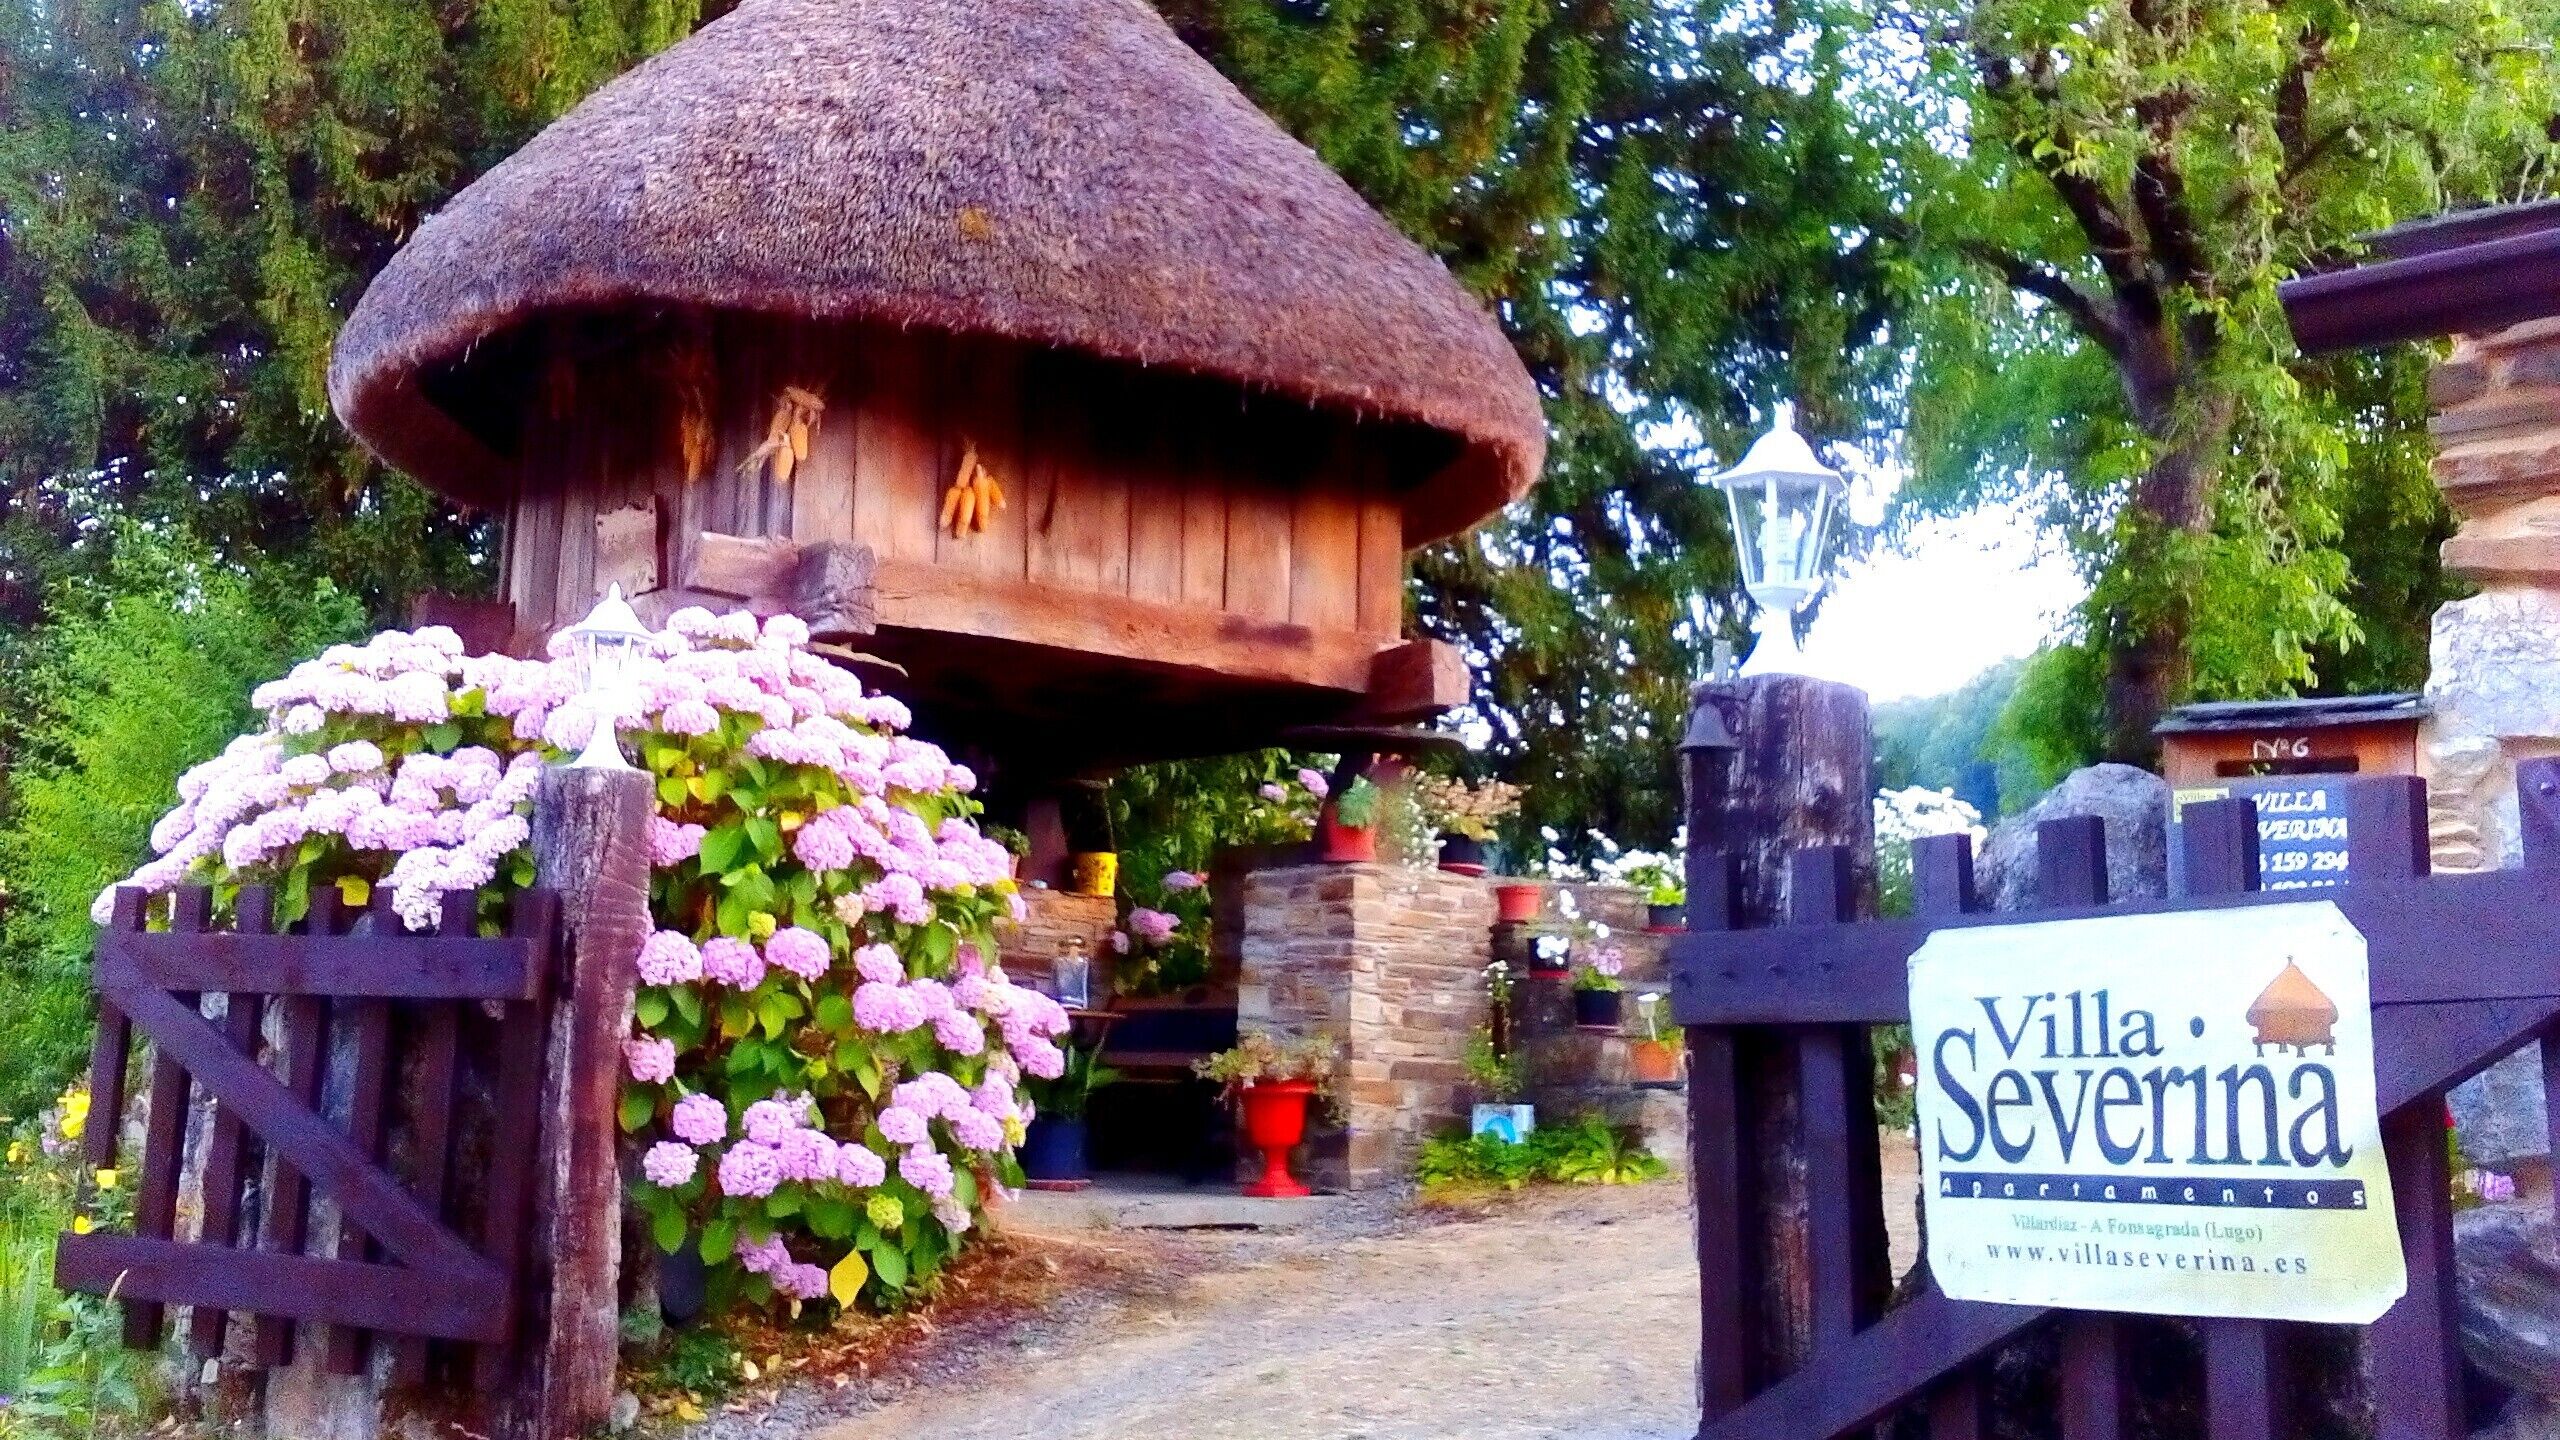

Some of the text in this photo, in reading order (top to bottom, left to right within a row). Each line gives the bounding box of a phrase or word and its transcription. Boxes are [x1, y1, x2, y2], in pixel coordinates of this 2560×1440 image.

[2252, 790, 2326, 813] VILLA
[2258, 817, 2347, 841] VERINA
[2272, 852, 2308, 872] 159
[2312, 850, 2349, 872] 294
[1974, 988, 2164, 1060] Villa
[1933, 1026, 2354, 1169] Severina
[1941, 1179, 2366, 1206] Apartamentos
[2090, 1218, 2103, 1233] A
[2107, 1217, 2201, 1240] Fonsagrada
[2204, 1221, 2263, 1243] (Lugo)
[1986, 1242, 2307, 1274] www.villaseverina.es
